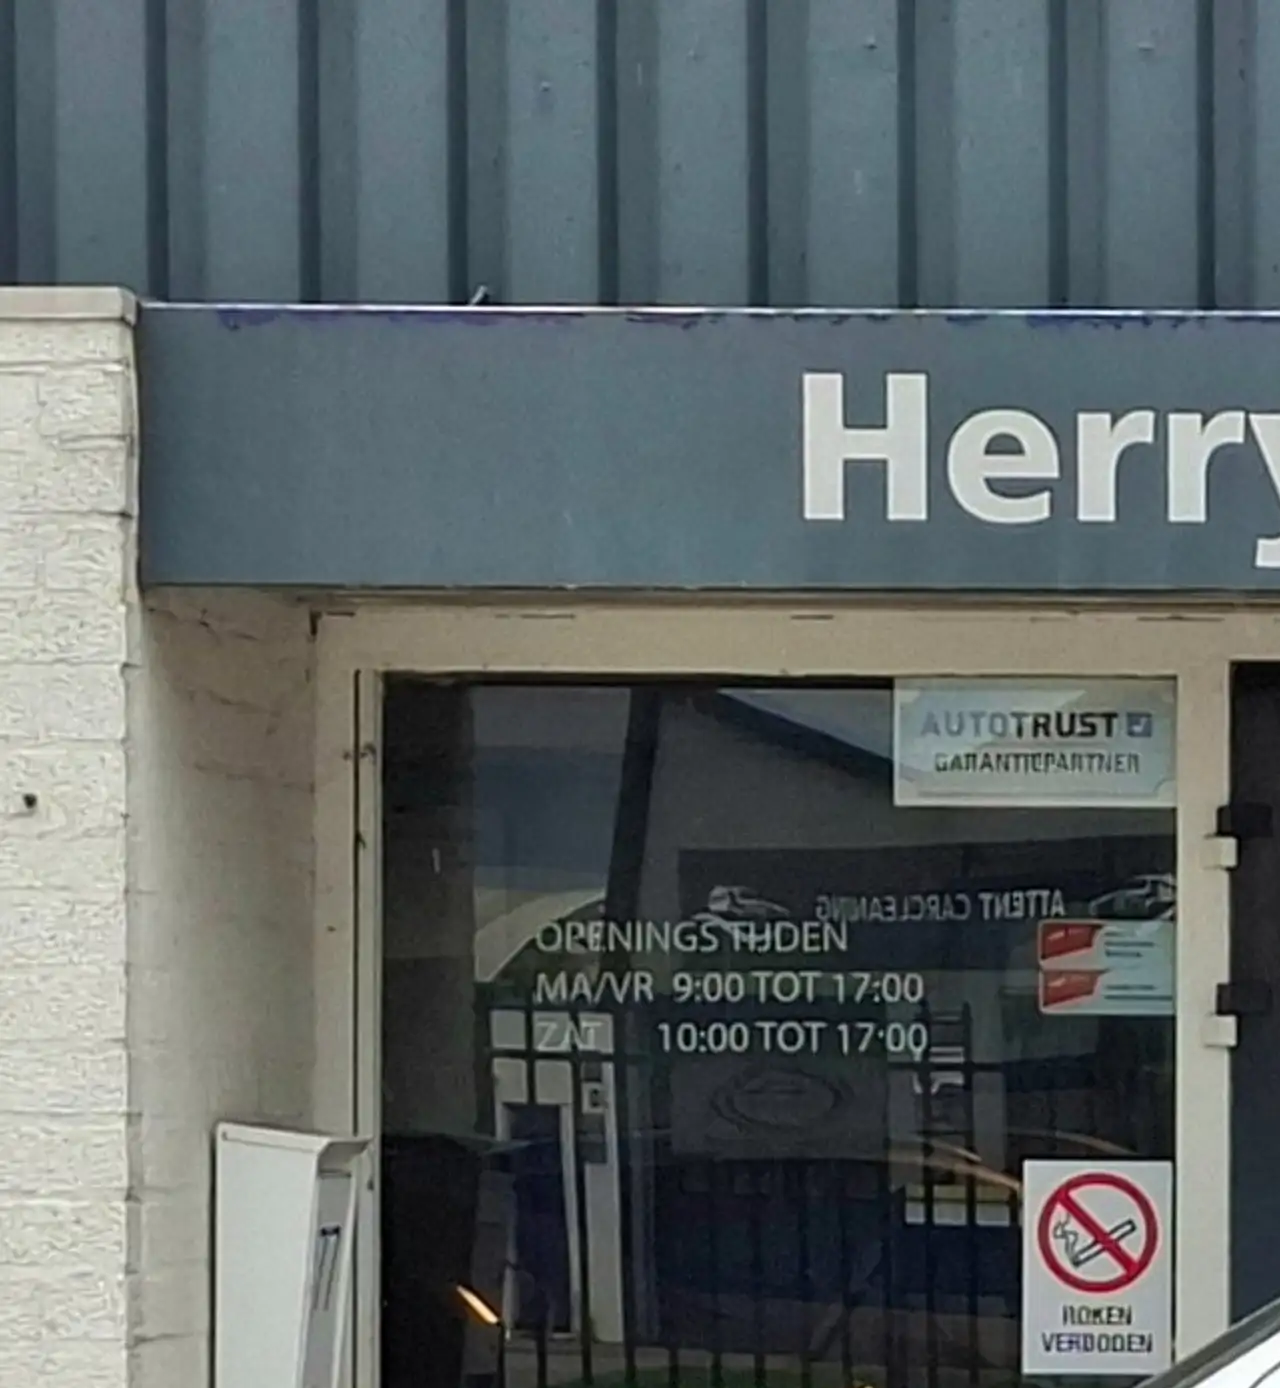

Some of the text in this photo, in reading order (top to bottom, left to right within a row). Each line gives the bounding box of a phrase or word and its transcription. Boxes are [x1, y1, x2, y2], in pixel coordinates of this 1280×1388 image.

[920, 710, 1119, 739] AUTOTRUST
[535, 920, 848, 953] OPENINGS TIJDEN
[534, 970, 924, 1004] MA/VR 9:00 TOT 17:00
[537, 1021, 928, 1055] ZAT 10:00 TOT 17:00
[1062, 1304, 1132, 1326] ROKEN
[1042, 1332, 1153, 1353] VERBODEN
